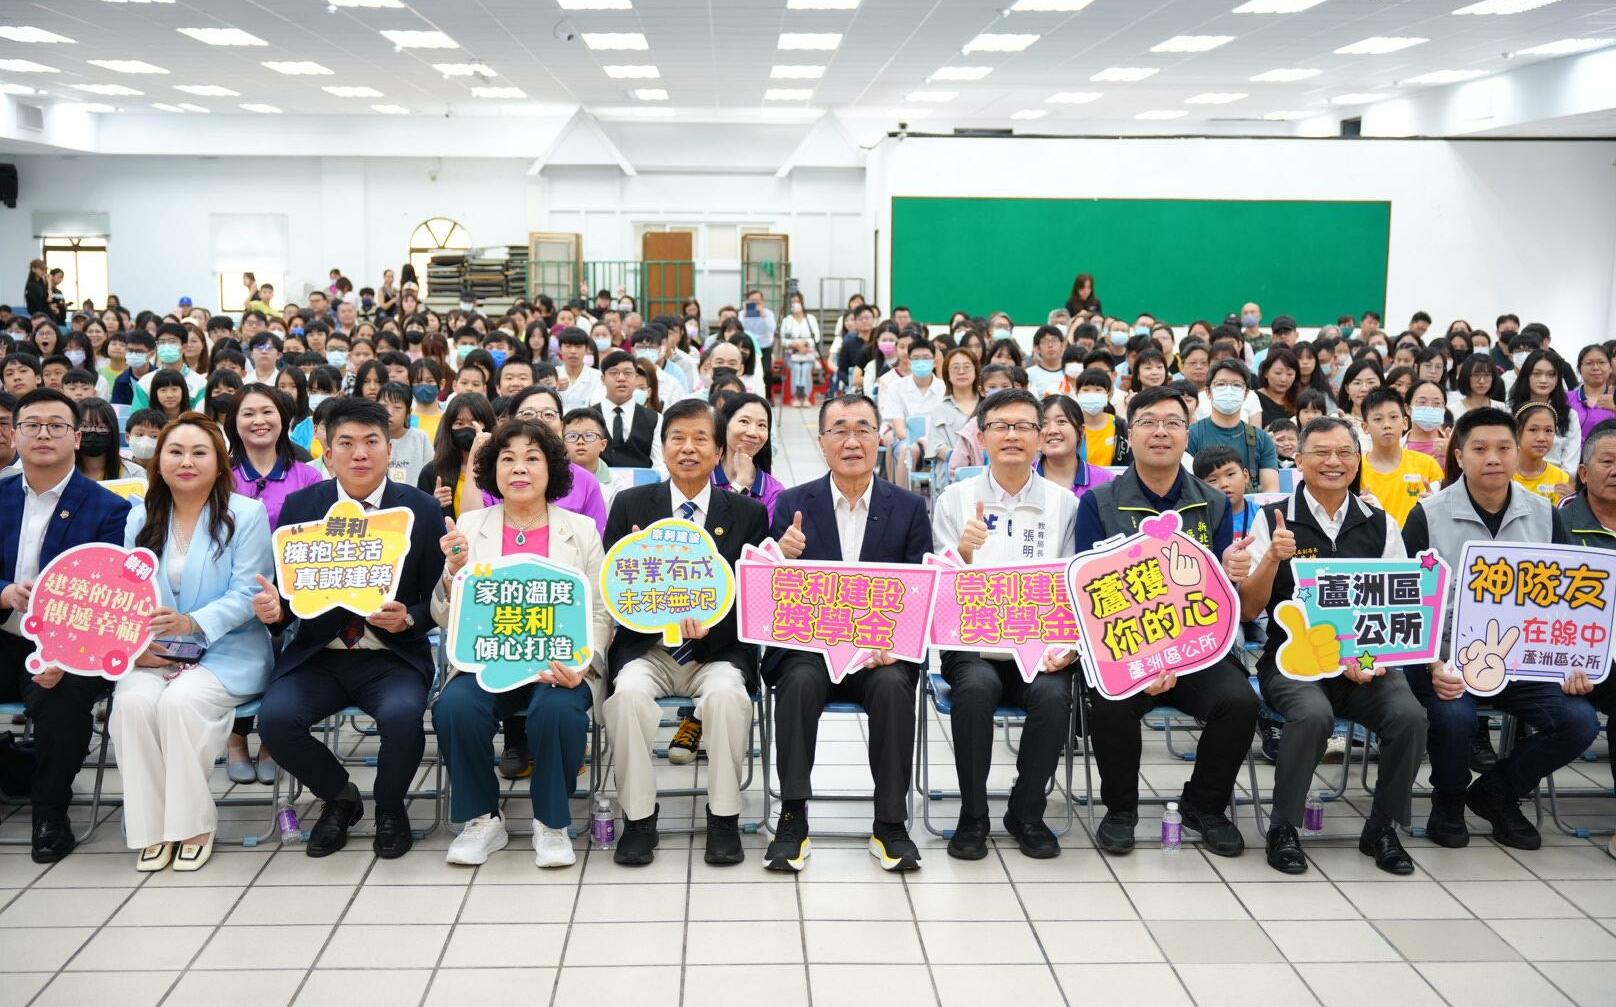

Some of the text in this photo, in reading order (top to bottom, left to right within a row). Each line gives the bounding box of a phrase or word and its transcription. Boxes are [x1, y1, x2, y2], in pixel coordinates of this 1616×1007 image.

[324, 517, 368, 538] 崇利
[284, 538, 384, 563] 擁抱生活
[1022, 529, 1035, 558] 張明
[123, 554, 153, 580] 崇利
[294, 564, 394, 590] 真誠建築
[615, 556, 713, 585] 學業有成
[43, 572, 154, 618] 建築的初心
[475, 580, 573, 606] 家的溫度
[772, 568, 906, 613] 崇利建設
[1085, 559, 1168, 618] 蘆獲
[1316, 571, 1422, 608] 蘆洲區
[1470, 556, 1610, 610] 神隊友
[617, 586, 717, 614] 未來無限
[43, 598, 141, 645] 傳遞幸福
[492, 606, 554, 636] 崇利
[773, 600, 896, 650] 獎學金
[959, 604, 1081, 644] 獎學金
[1103, 592, 1219, 661] 你的心
[1353, 611, 1423, 647] 公所
[1522, 617, 1607, 648] 在線中
[474, 636, 573, 662] 傾心打造
[1126, 632, 1218, 680] 蘆洲區公所
[1522, 649, 1600, 670] 蘆洲區公所
